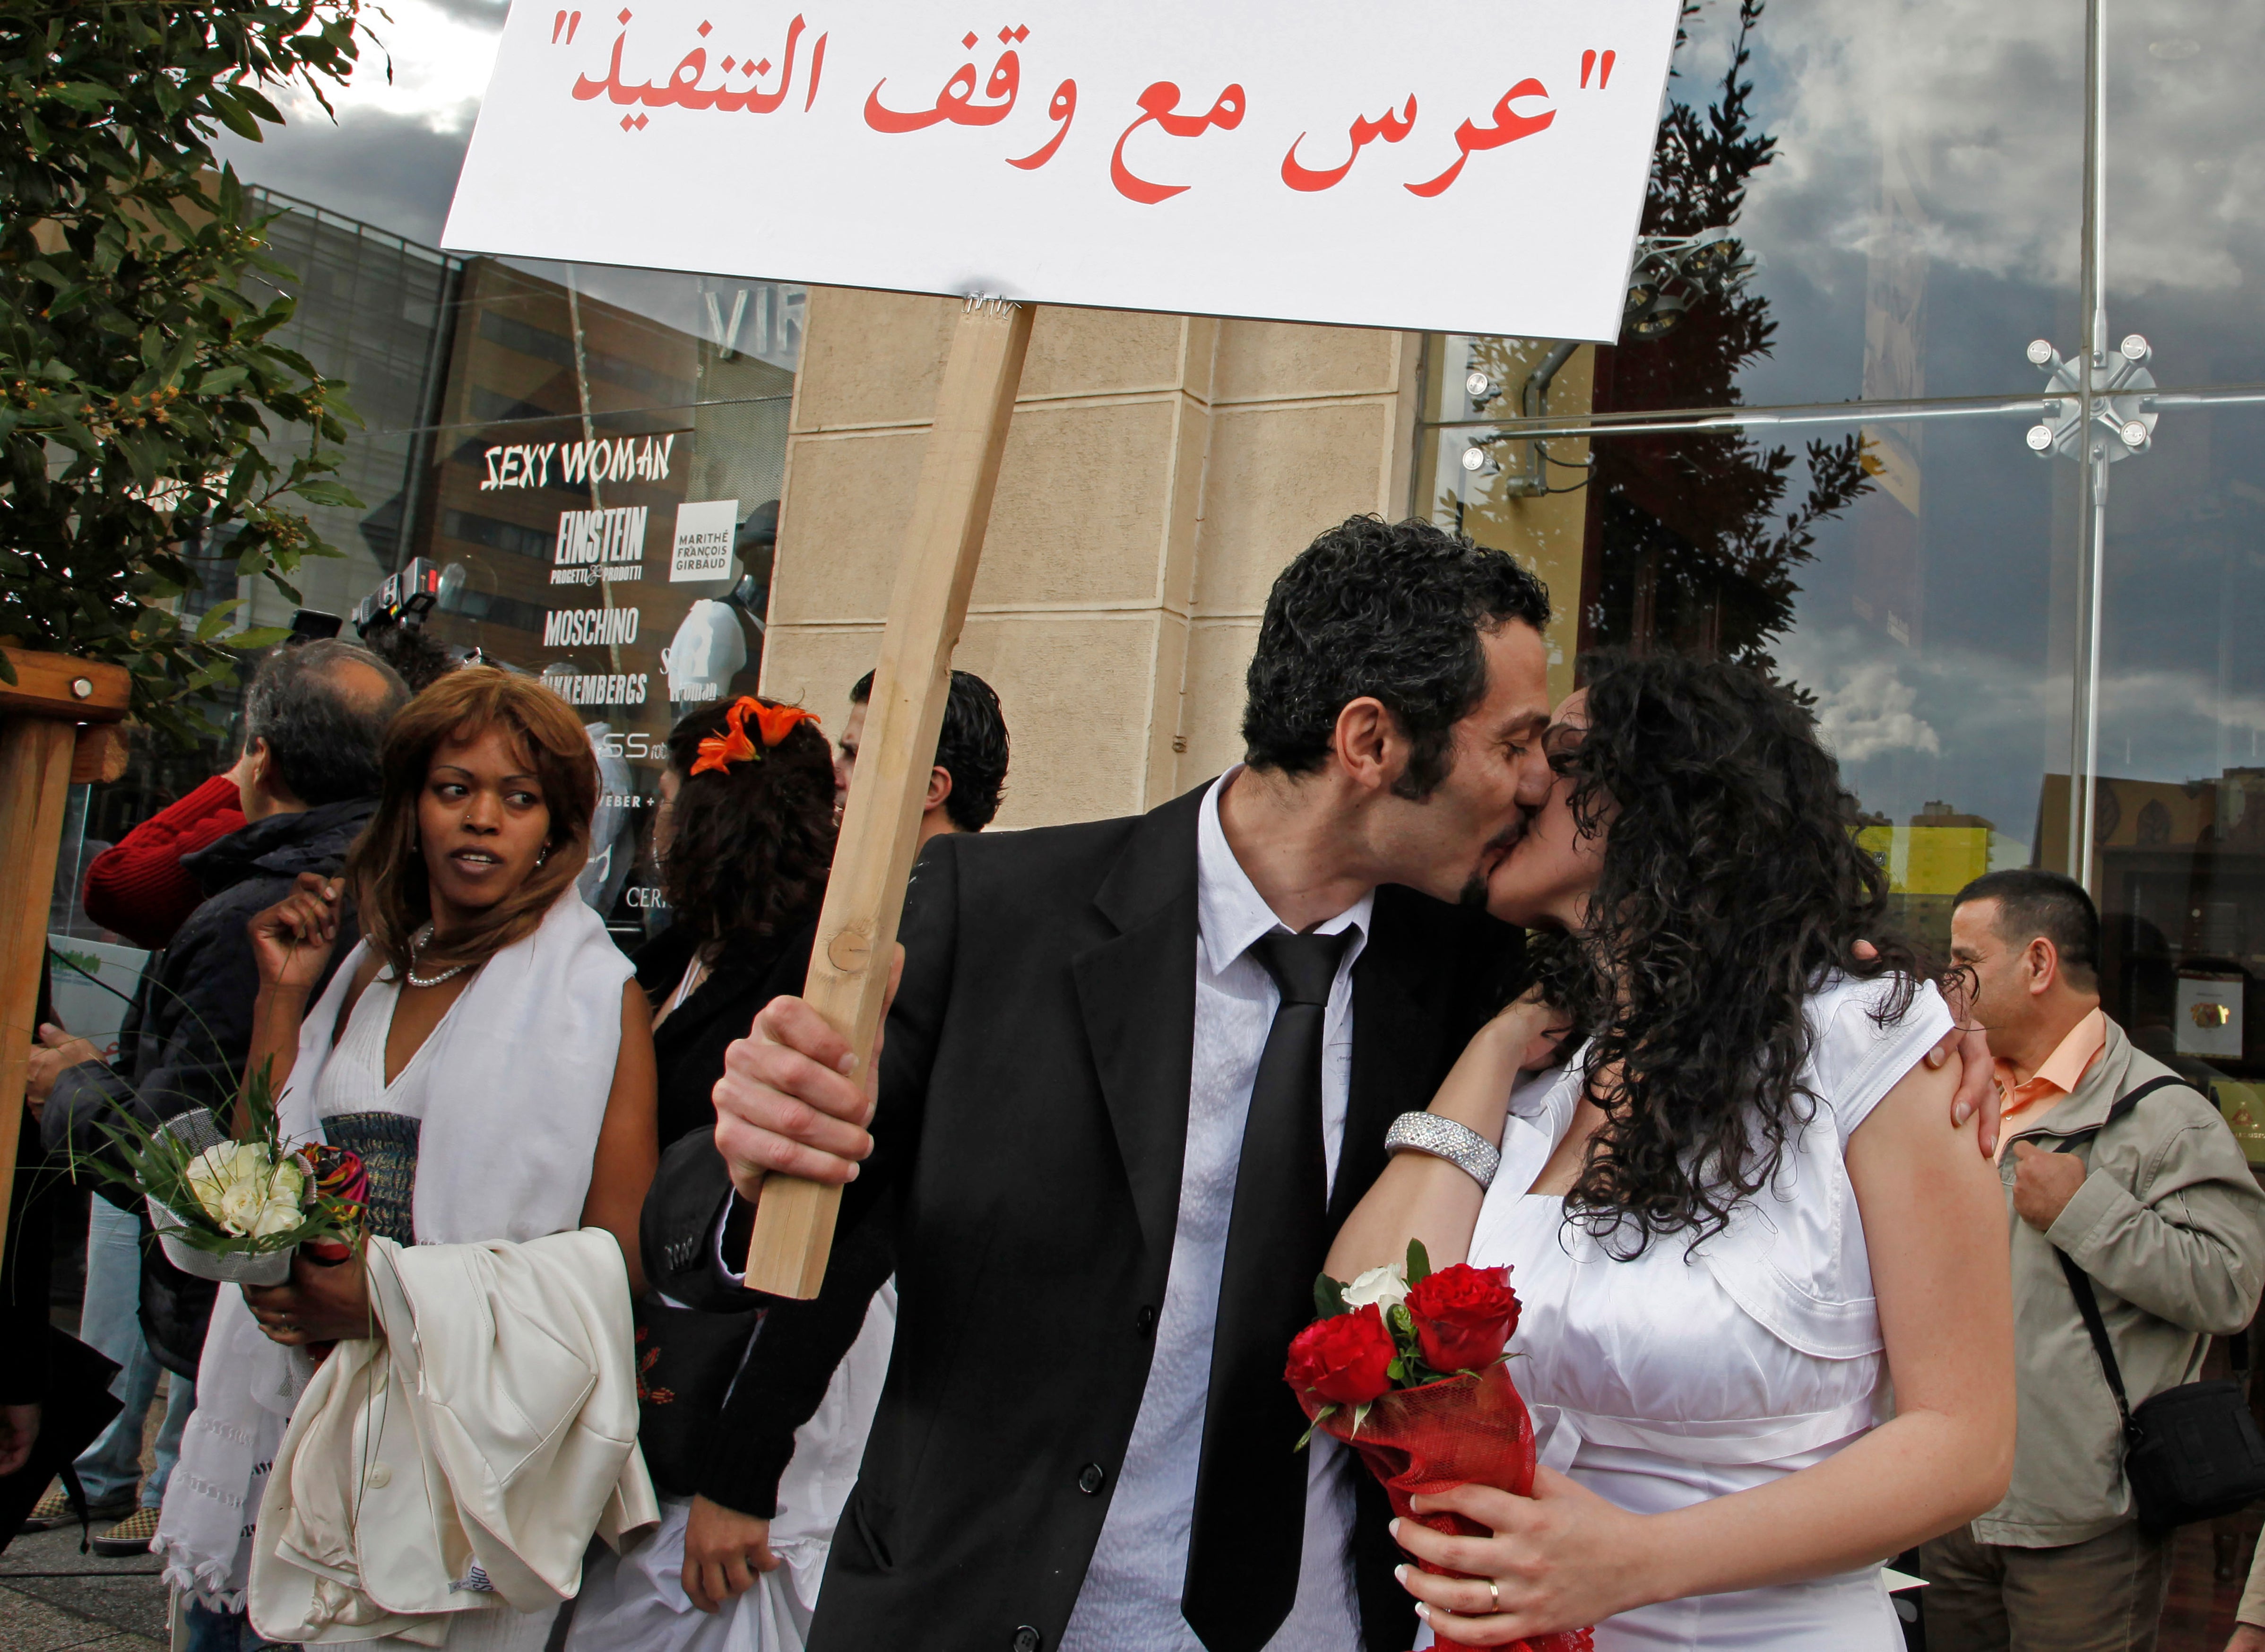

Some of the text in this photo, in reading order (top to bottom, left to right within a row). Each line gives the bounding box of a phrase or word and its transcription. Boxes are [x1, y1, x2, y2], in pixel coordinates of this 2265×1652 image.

[864, 24, 1077, 171] وقف
[1110, 81, 1246, 205] مع
[479, 433, 674, 491] SEXY WOMAN
[554, 506, 648, 564] EINSTEIN
[679, 529, 728, 545] MARITHÉ
[550, 569, 588, 584] PROGETTI
[603, 565, 642, 581] PRODOTTI
[676, 558, 726, 571] GIRBAUD
[544, 607, 639, 646] MOSCHINO
[626, 887, 673, 908] CER
